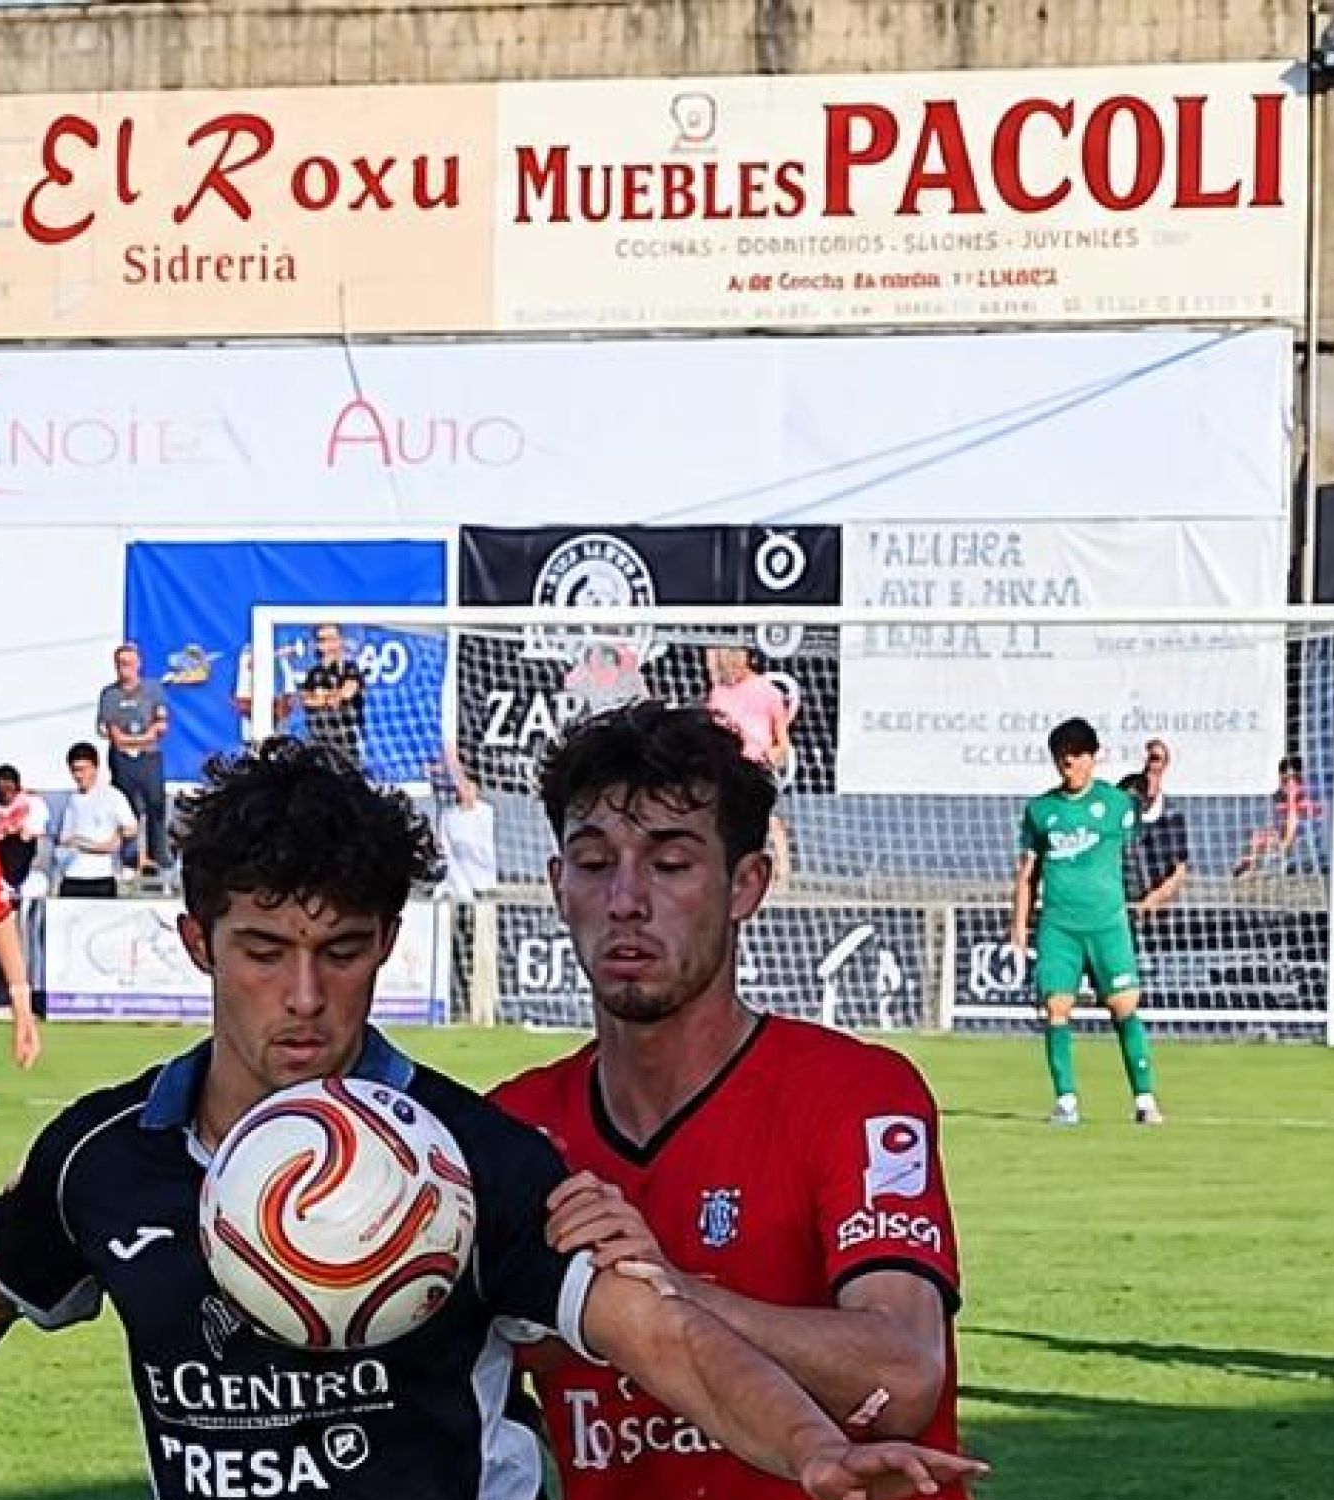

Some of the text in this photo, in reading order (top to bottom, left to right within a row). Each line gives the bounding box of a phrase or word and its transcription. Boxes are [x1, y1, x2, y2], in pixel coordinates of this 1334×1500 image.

[22, 110, 462, 246] El Roxu
[513, 92, 1287, 223] MUEBLES PACOLI
